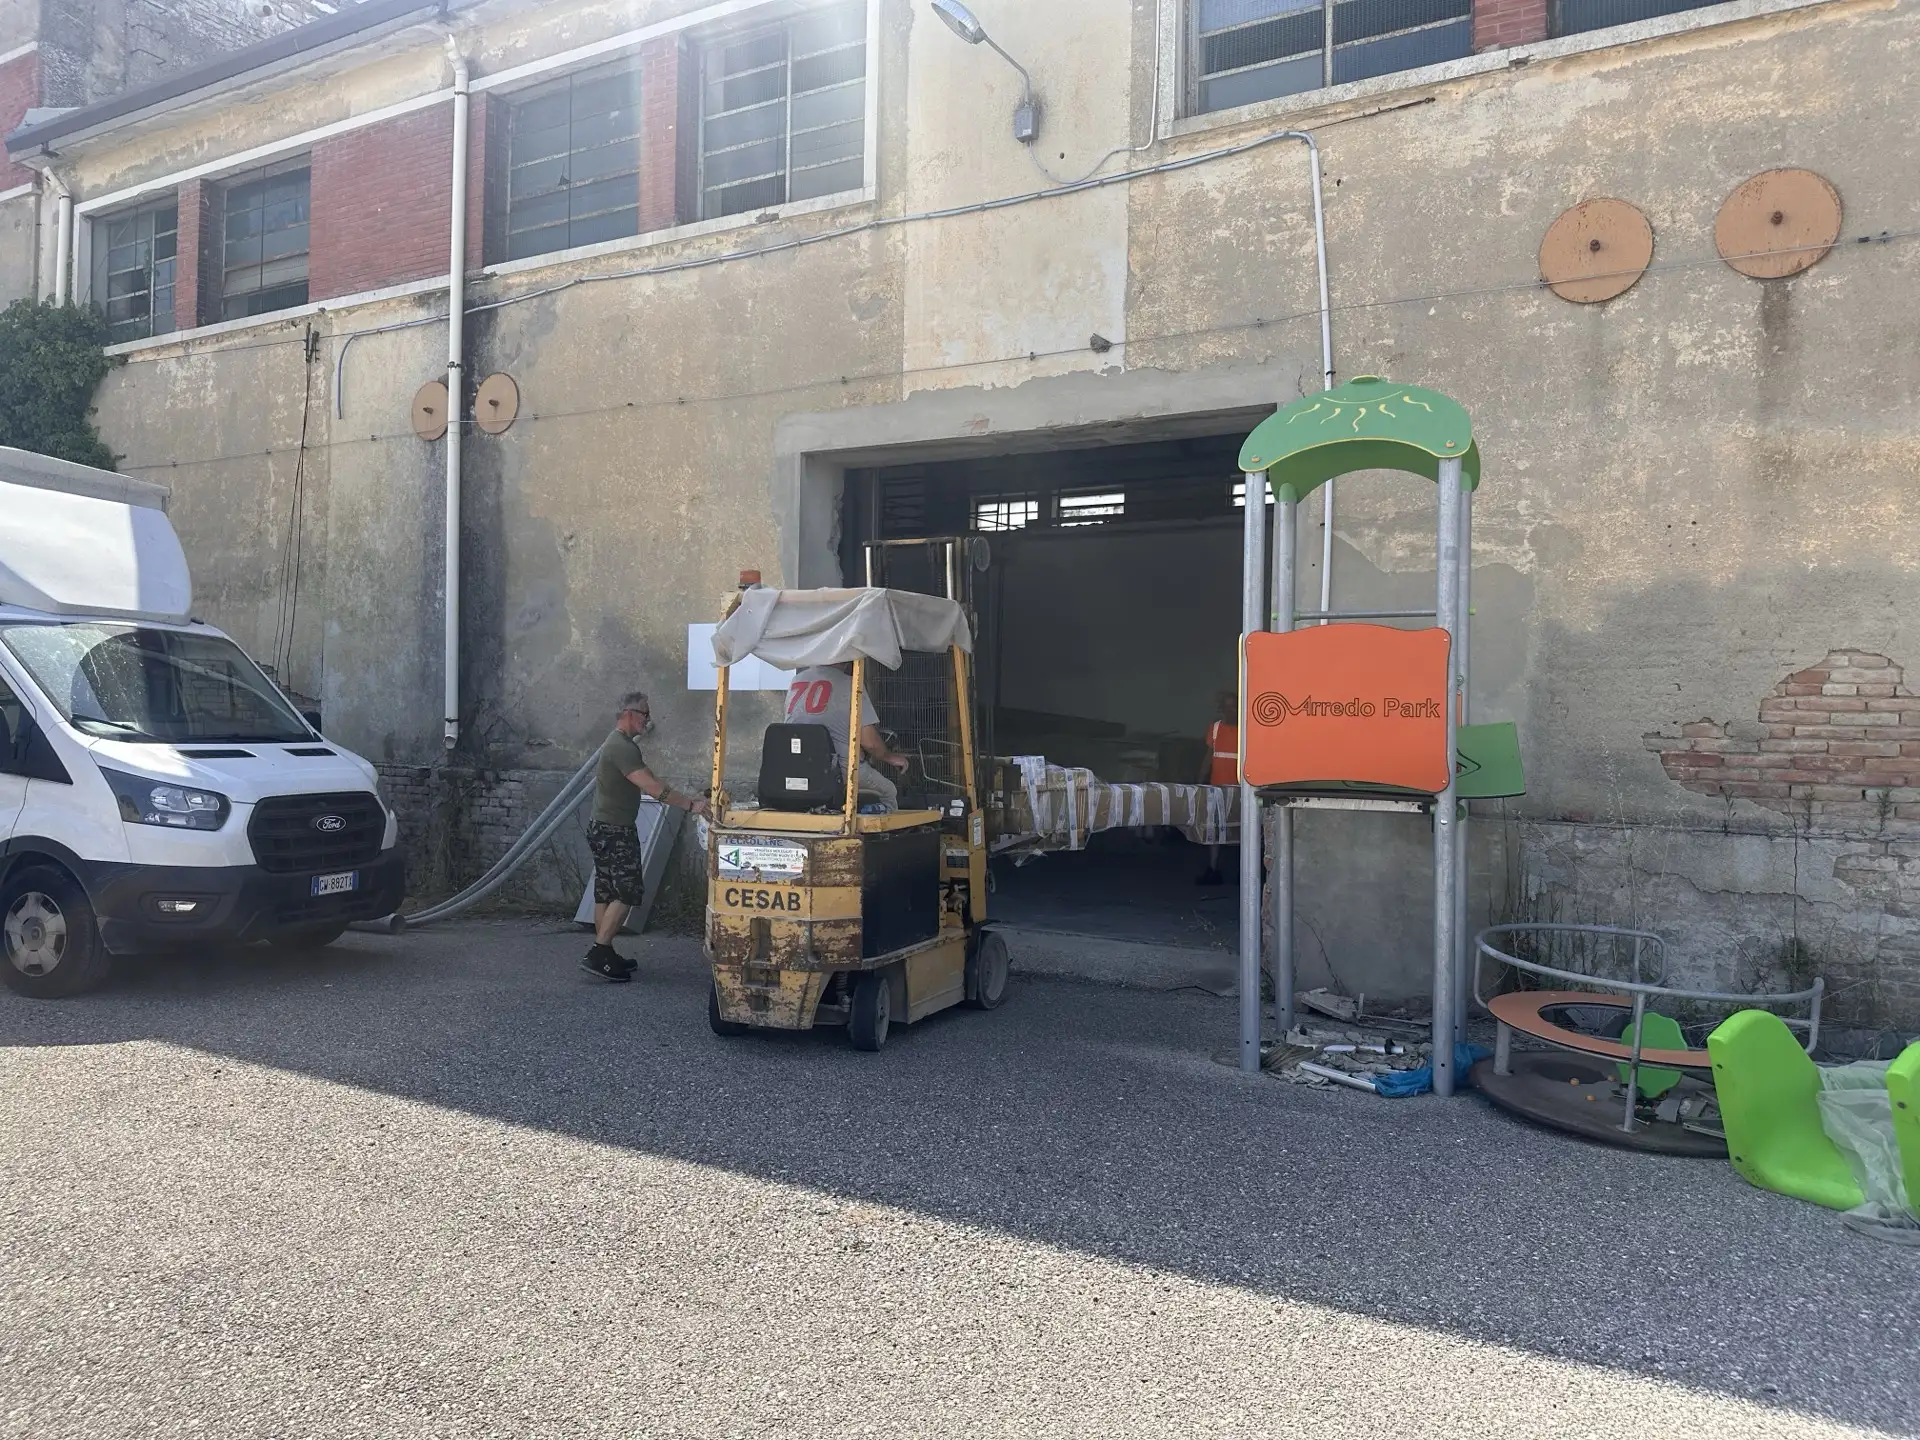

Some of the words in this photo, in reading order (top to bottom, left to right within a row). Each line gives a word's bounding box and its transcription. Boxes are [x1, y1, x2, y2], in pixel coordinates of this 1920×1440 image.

[787, 680, 832, 714] 70
[1299, 695, 1376, 717] Arredo
[1383, 697, 1440, 718] Park
[322, 818, 341, 829] Ford
[725, 887, 801, 911] CESAB
